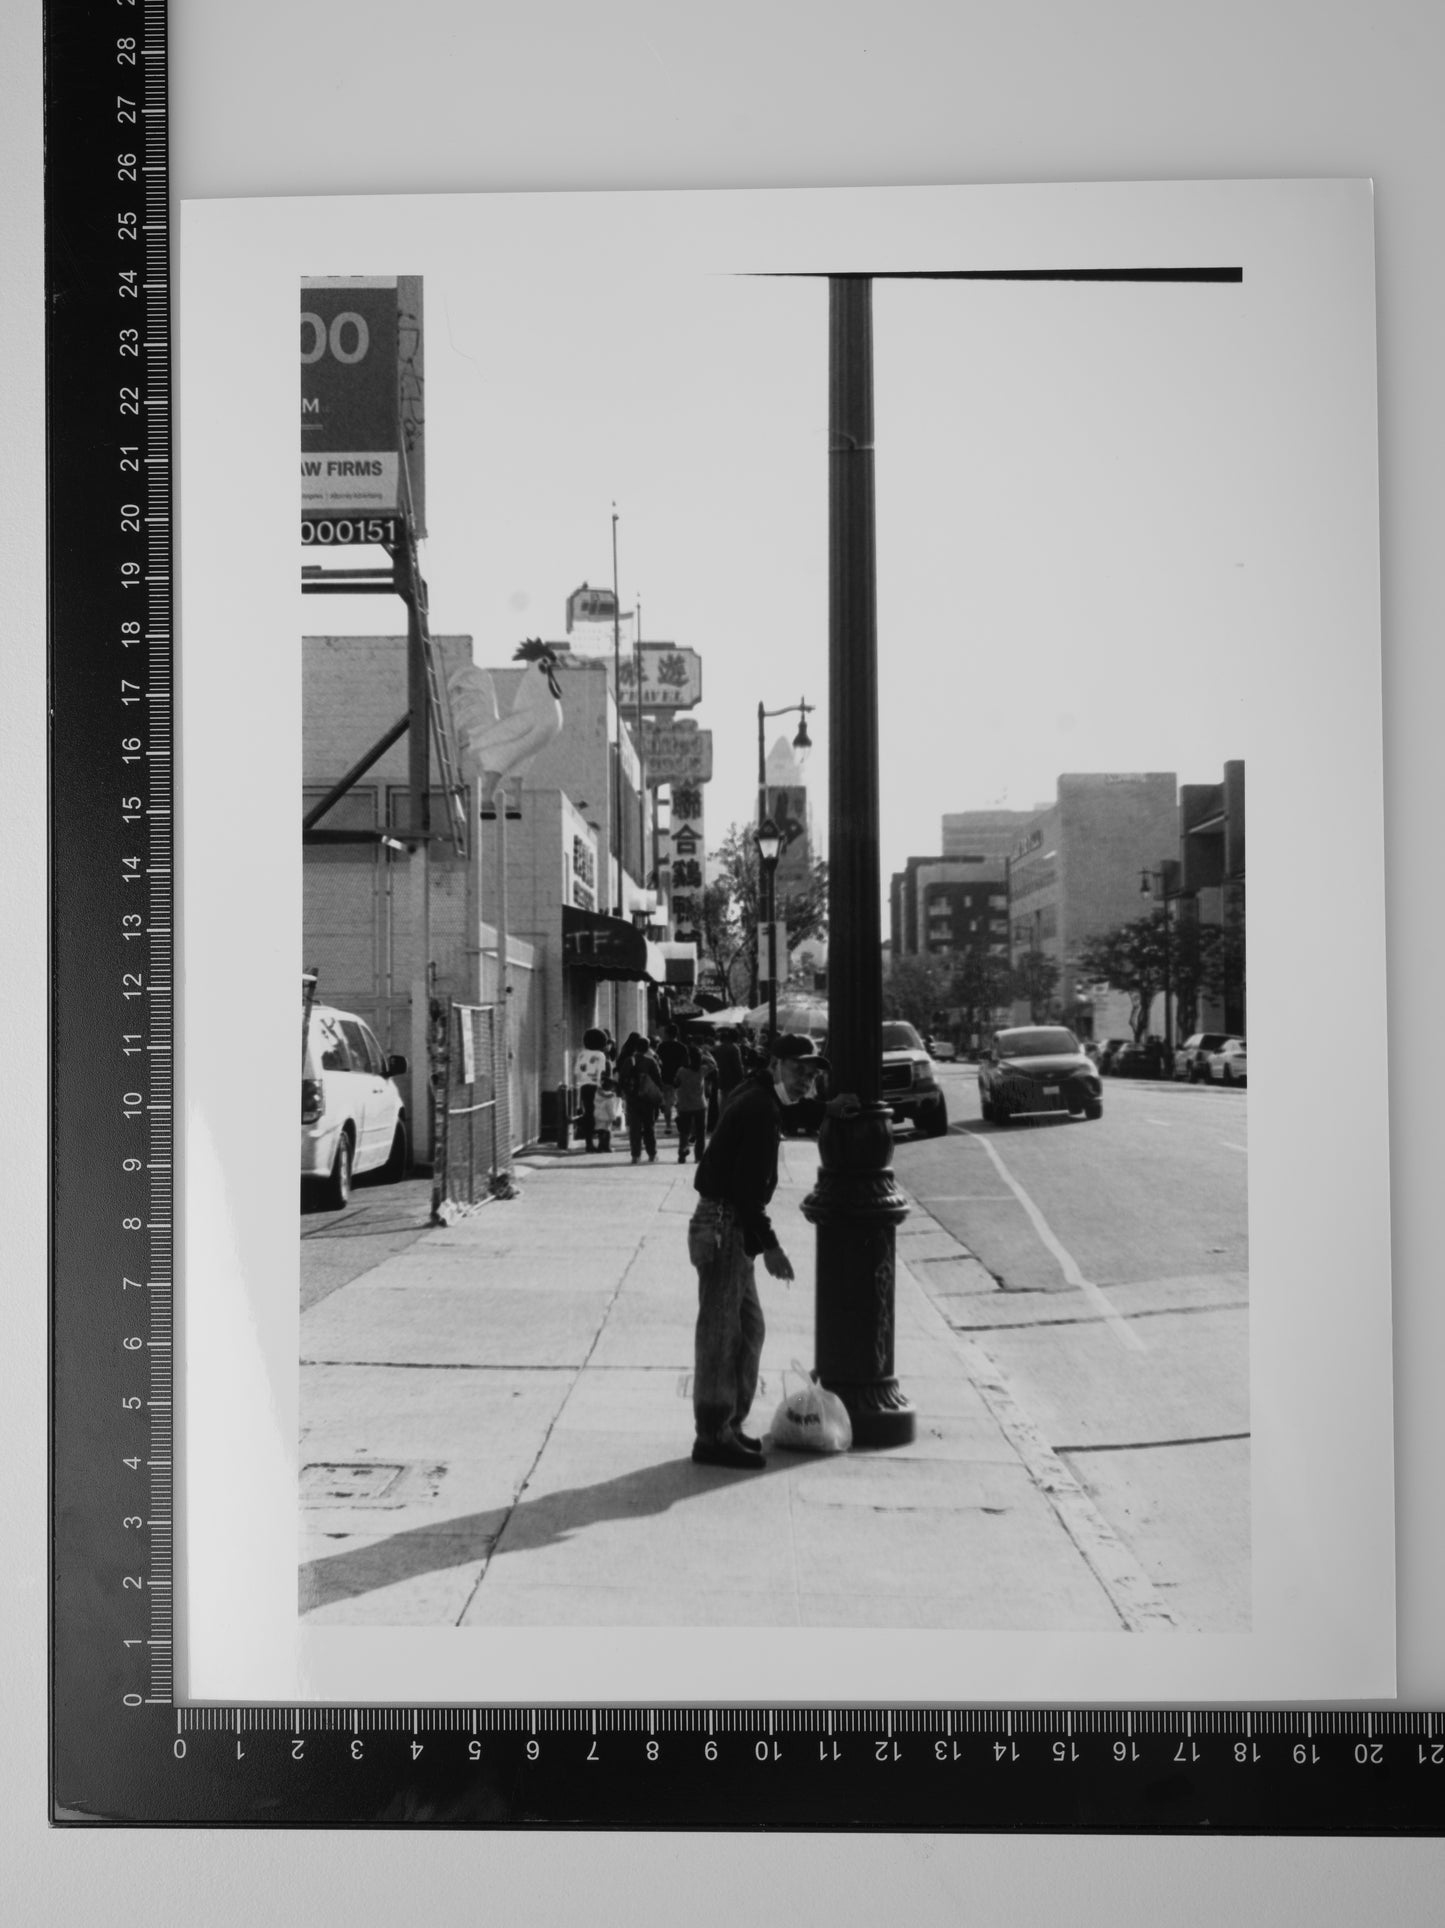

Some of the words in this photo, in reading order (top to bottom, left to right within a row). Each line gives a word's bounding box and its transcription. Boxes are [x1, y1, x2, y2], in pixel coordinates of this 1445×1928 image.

[116, 36, 137, 66] 28
[116, 95, 137, 124] 27
[117, 153, 137, 182] 26
[117, 211, 137, 241] 25
[118, 269, 138, 299] 24
[118, 328, 139, 357] 23
[119, 386, 140, 416] 22
[301, 398, 320, 414] M
[119, 446, 140, 472] 21
[327, 460, 383, 478] FIRMS
[120, 503, 140, 533] 20
[301, 519, 396, 544] 000151
[120, 561, 141, 589] 19
[120, 621, 141, 648] 18
[120, 679, 141, 706] 17
[121, 737, 142, 765] 16
[121, 796, 142, 824] 15
[121, 855, 142, 883] 14
[122, 913, 142, 941] 13
[122, 973, 142, 1001] 12
[122, 1034, 142, 1057] 11
[122, 1092, 143, 1119] 10
[122, 1158, 142, 1172] 9
[122, 1217, 142, 1231] 8
[122, 1276, 143, 1290] 7
[122, 1336, 143, 1351] 6
[122, 1396, 142, 1410] 5
[122, 1456, 142, 1471] 4
[122, 1515, 143, 1529] 3
[122, 1576, 142, 1590] 2
[122, 1639, 143, 1648] 1
[122, 1693, 143, 1707] 0
[173, 1738, 187, 1759] 0
[236, 1740, 246, 1761] 1
[291, 1739, 305, 1760] 2
[350, 1739, 364, 1761] 3
[409, 1740, 424, 1761] 4
[468, 1740, 482, 1761] 5
[586, 1740, 600, 1761] 7
[645, 1740, 660, 1761] 8
[754, 1740, 783, 1761] 10
[819, 1740, 842, 1761] 11
[874, 1741, 903, 1762] 12
[934, 1740, 962, 1761] 13
[992, 1741, 1021, 1762] 14
[1052, 1741, 1080, 1762] 15
[1112, 1741, 1141, 1762] 16
[1173, 1741, 1201, 1762] 17
[1233, 1742, 1262, 1763] 18
[1292, 1743, 1321, 1765] 19
[1354, 1743, 1384, 1764] 20
[1418, 1743, 1445, 1765] 21
